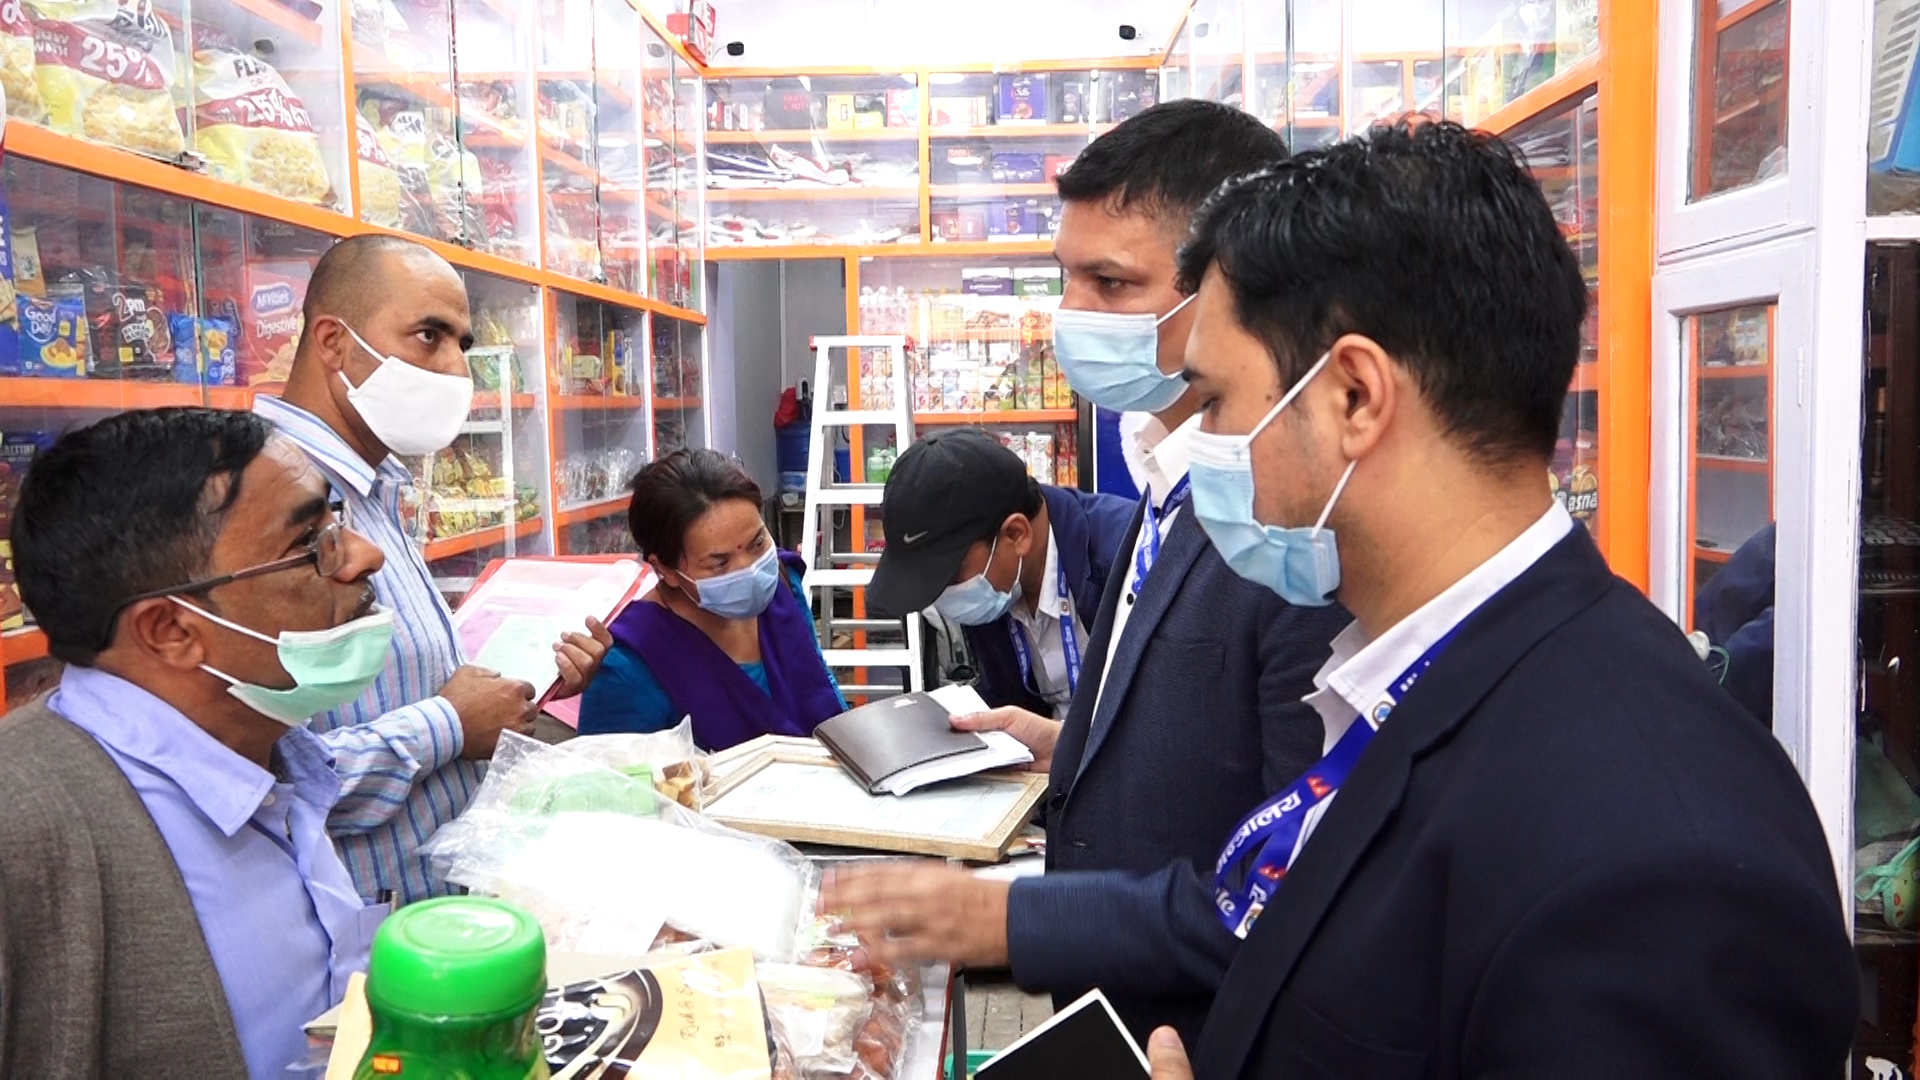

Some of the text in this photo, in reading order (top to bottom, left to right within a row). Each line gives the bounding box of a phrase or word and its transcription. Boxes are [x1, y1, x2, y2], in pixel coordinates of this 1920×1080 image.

[24, 305, 57, 323] Good
[112, 292, 146, 322] 2pm
[31, 320, 53, 337] Day
[256, 313, 298, 339] Digestive
